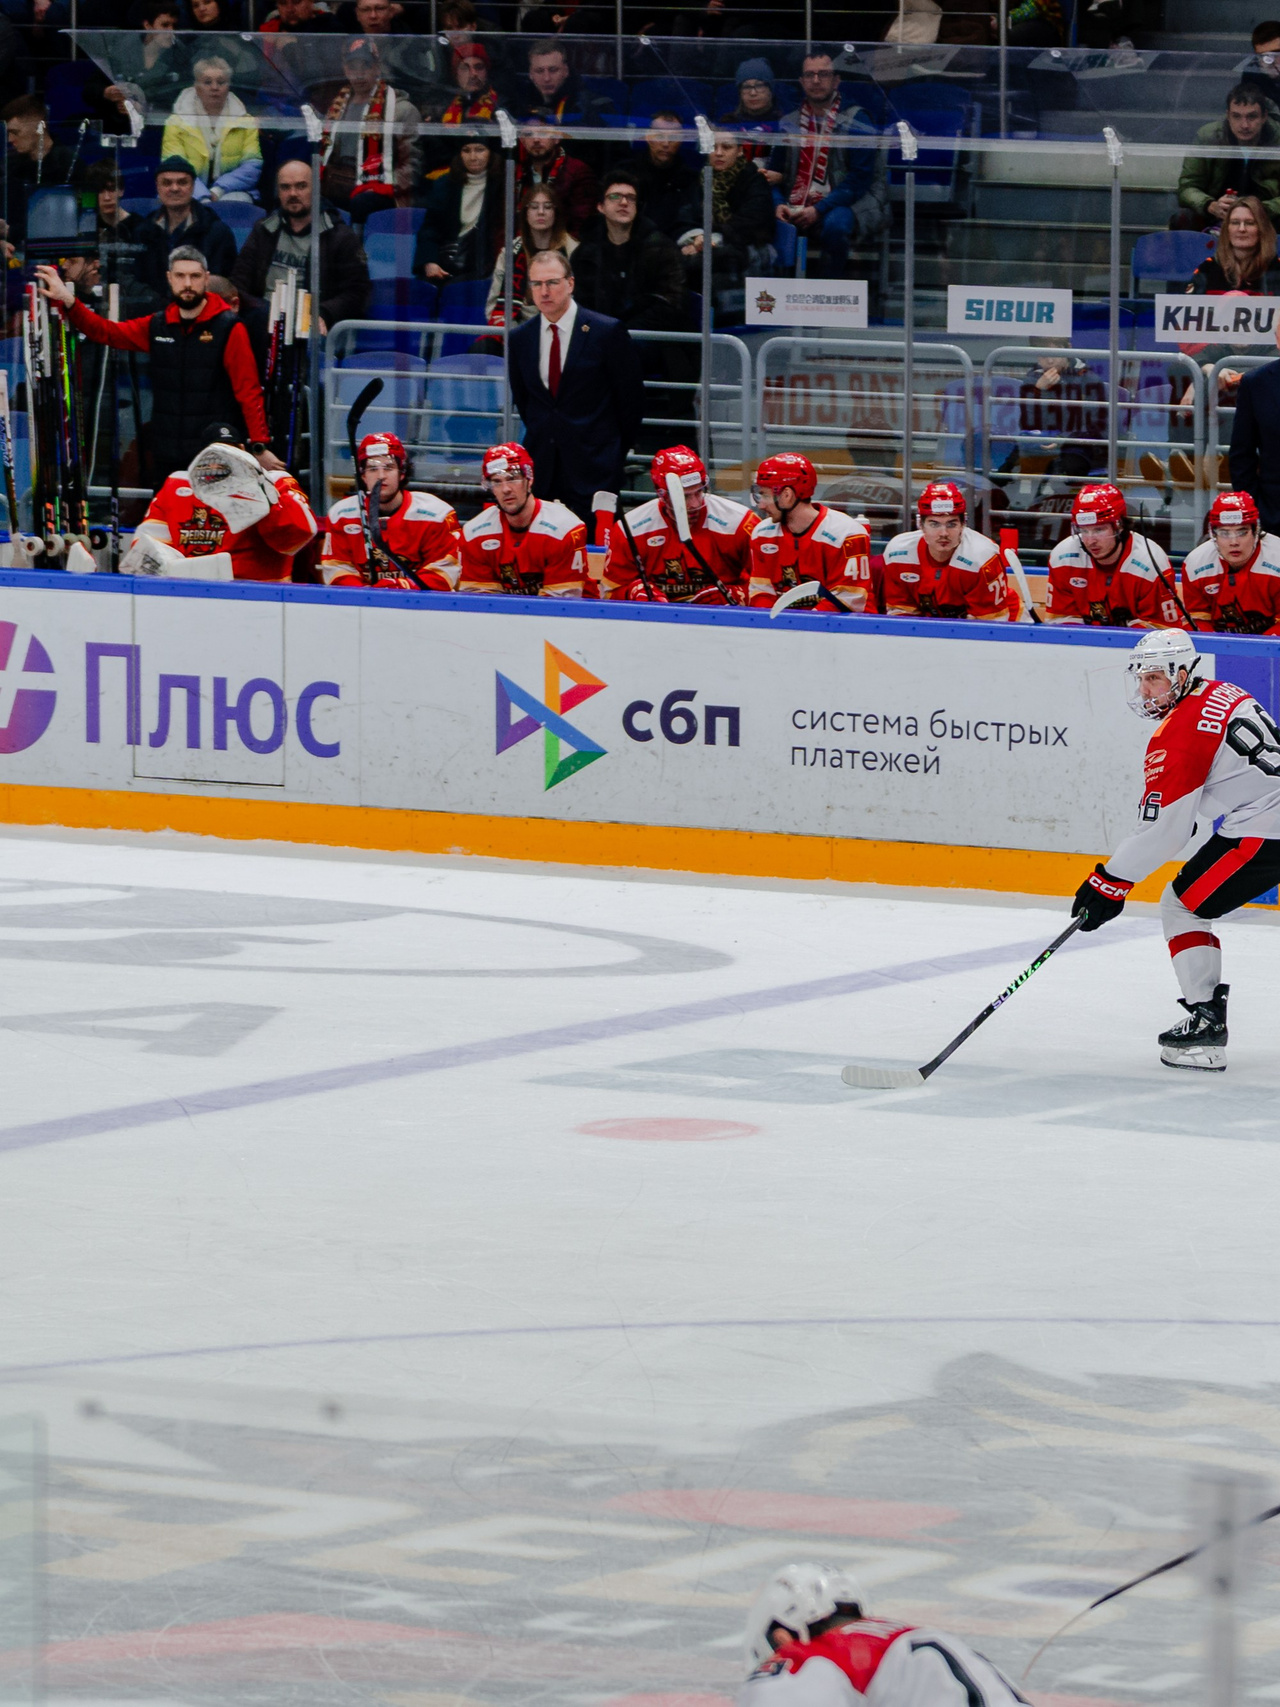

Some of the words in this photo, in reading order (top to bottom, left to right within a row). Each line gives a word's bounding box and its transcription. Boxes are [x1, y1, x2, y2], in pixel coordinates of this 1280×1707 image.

[965, 299, 1055, 324] SIBUR
[1162, 306, 1275, 333] KHL.RU
[844, 555, 871, 581] 40
[987, 575, 1007, 607] 25
[86, 643, 340, 757] Плюс
[792, 709, 918, 737] система
[927, 709, 1068, 752] быстрых
[791, 746, 940, 775] платежей
[1088, 876, 1131, 898] CCM
